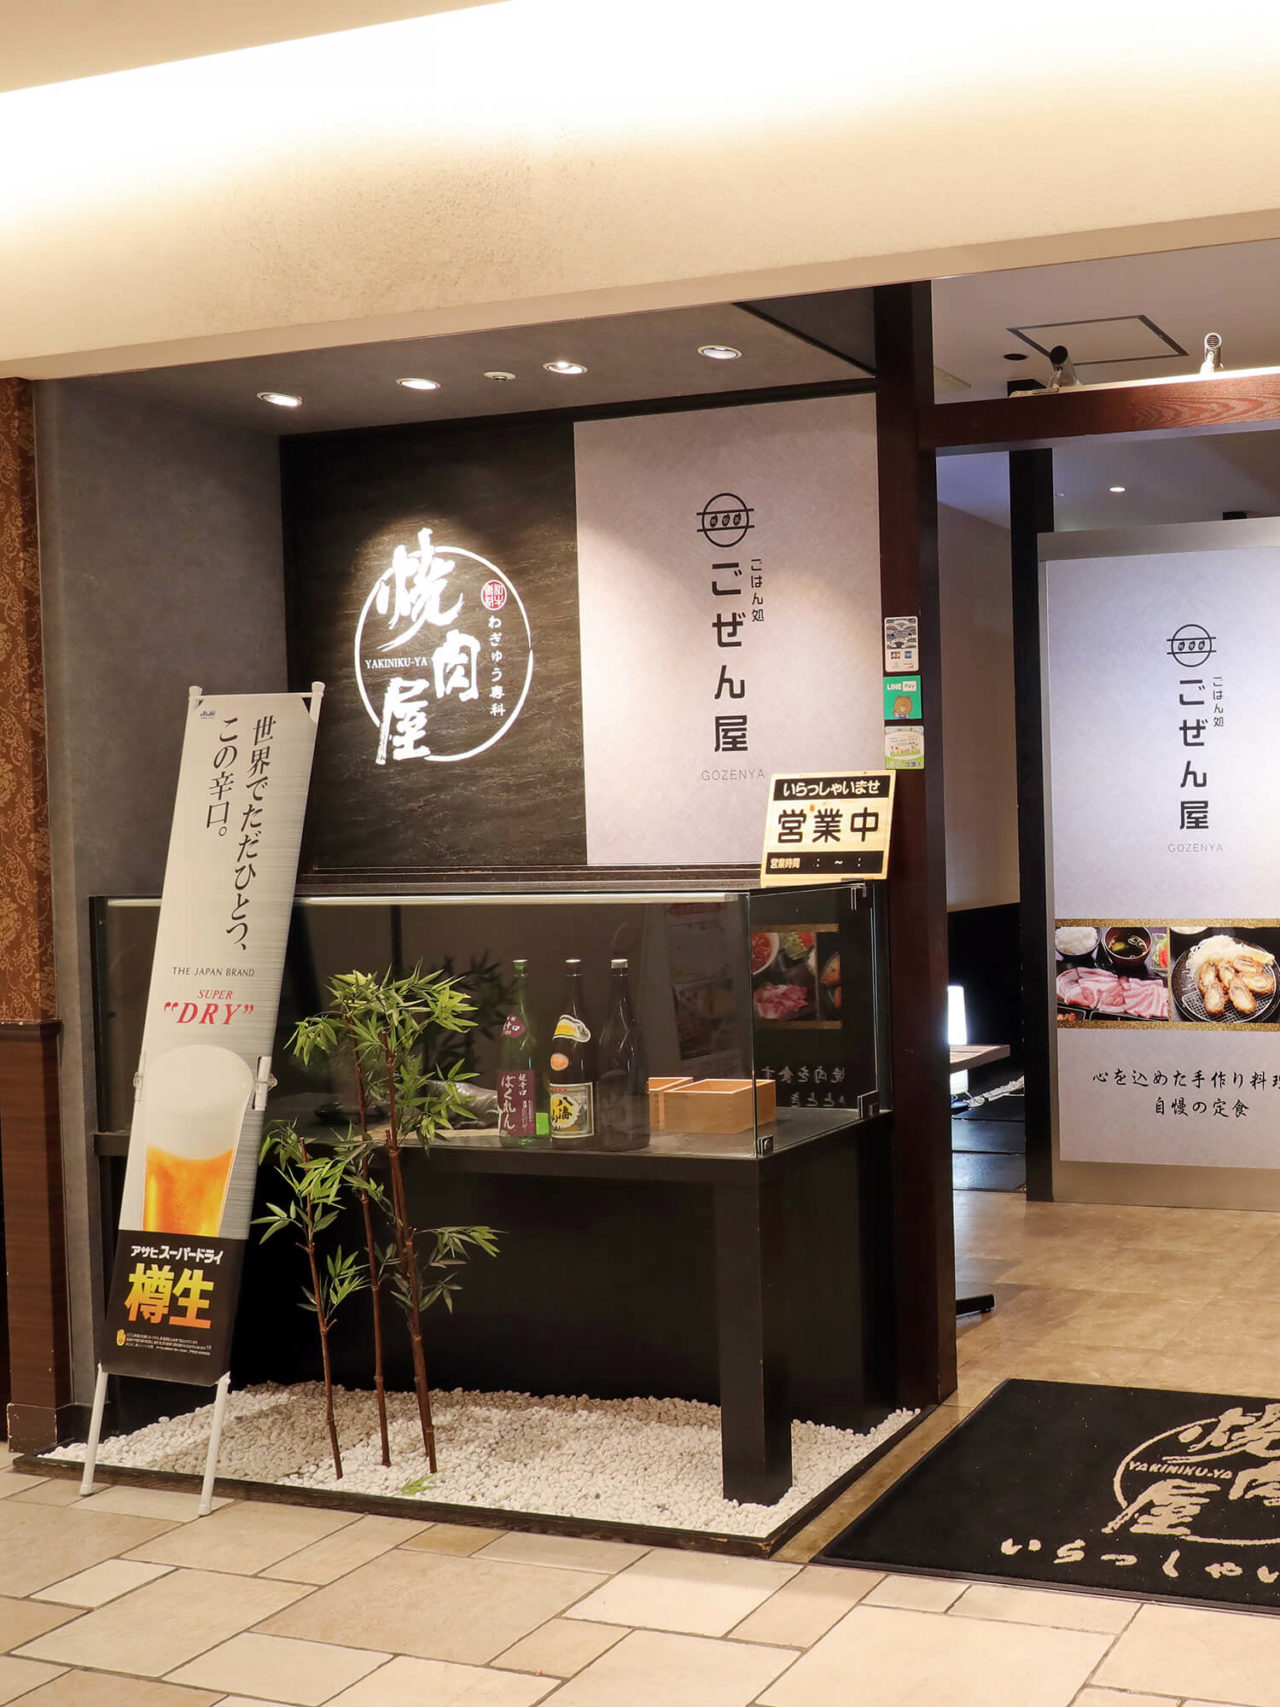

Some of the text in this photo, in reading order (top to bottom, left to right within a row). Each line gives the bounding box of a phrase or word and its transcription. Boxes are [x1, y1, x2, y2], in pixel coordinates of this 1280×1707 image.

[750, 558, 765, 622] ごはん処
[365, 656, 428, 669] YAKINIKU-YA
[711, 562, 748, 752] ごぜん屋
[1212, 676, 1224, 727] ごはん処
[1179, 679, 1209, 830] ごぜん屋
[206, 717, 238, 837] この辛口。
[701, 769, 765, 782] GOZENYA
[783, 779, 880, 796] いらっしゃいませ
[226, 715, 276, 951] 世界でただひとつ、
[778, 807, 879, 843] 営業中
[1168, 843, 1223, 852] GOZENYA
[770, 858, 800, 868] 営業時間
[172, 966, 255, 977] THE JAPAN BRAND
[197, 989, 233, 1000] SUPER
[1155, 1096, 1250, 1118] 自慢の定食
[131, 1246, 223, 1264] アサヒスーパードライ
[124, 1263, 214, 1329] 樽生
[1129, 1461, 1233, 1480] YAKINIKU-YA
